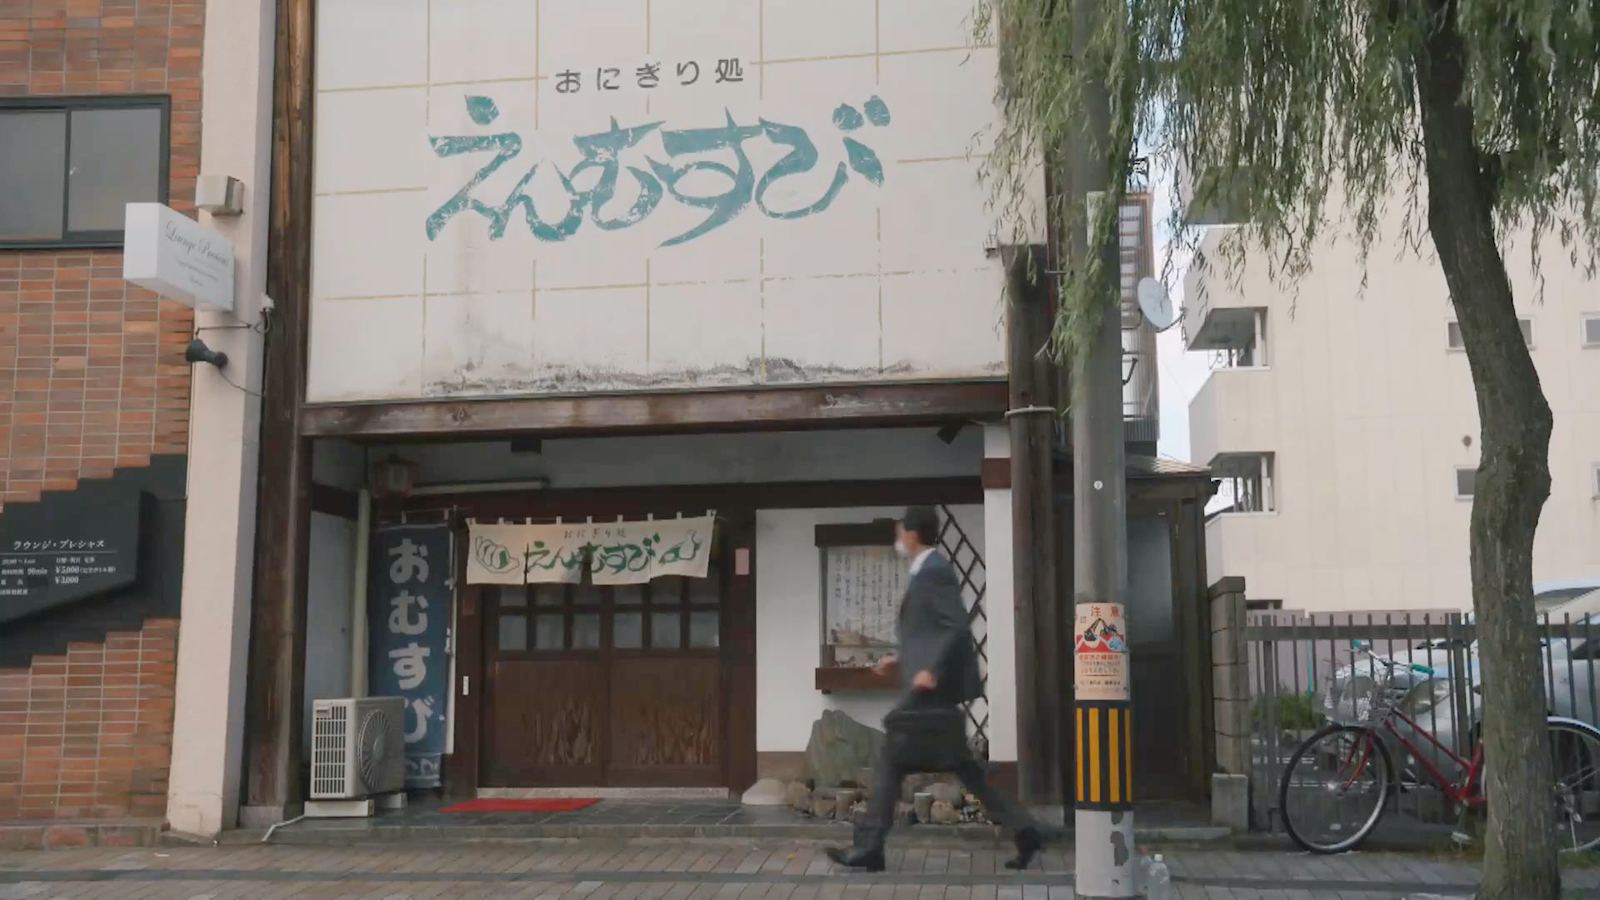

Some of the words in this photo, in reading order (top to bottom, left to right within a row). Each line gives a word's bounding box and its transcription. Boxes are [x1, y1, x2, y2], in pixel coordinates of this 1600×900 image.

[555, 57, 745, 94] おにぎり処
[425, 94, 892, 250] えんむすび
[388, 537, 435, 744] おむすび
